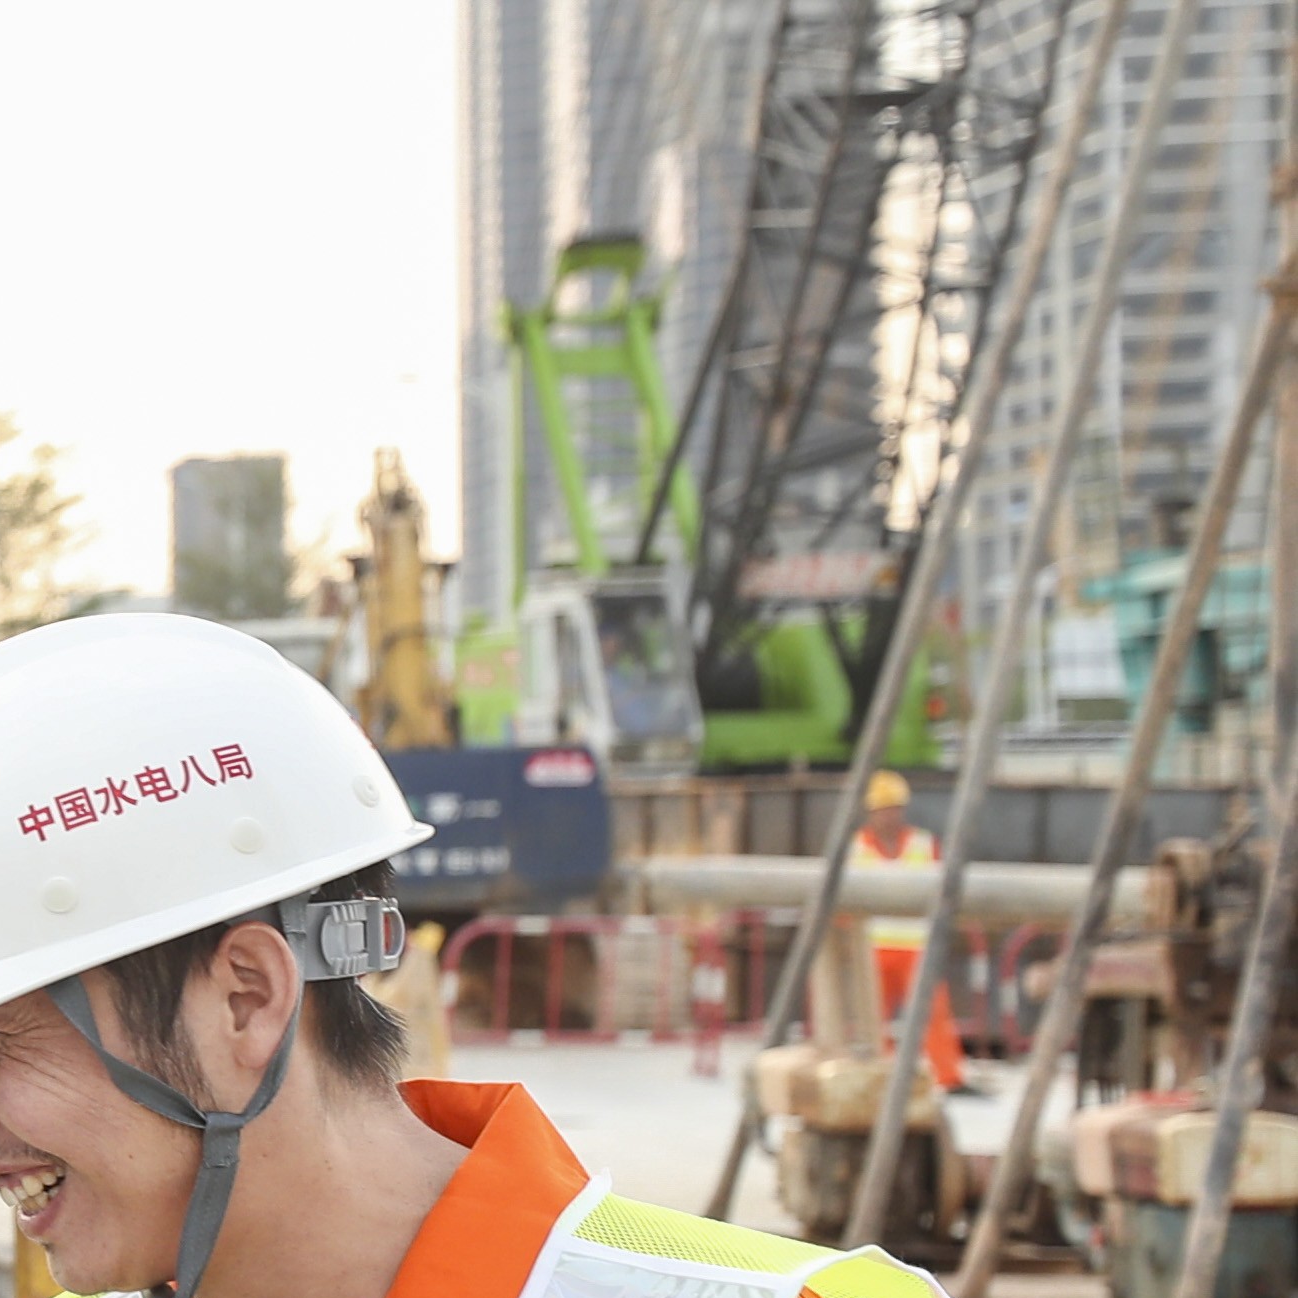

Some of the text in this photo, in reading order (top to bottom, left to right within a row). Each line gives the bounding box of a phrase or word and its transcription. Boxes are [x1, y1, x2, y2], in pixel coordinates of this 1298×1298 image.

[17, 743, 254, 841] 中国水电八局
